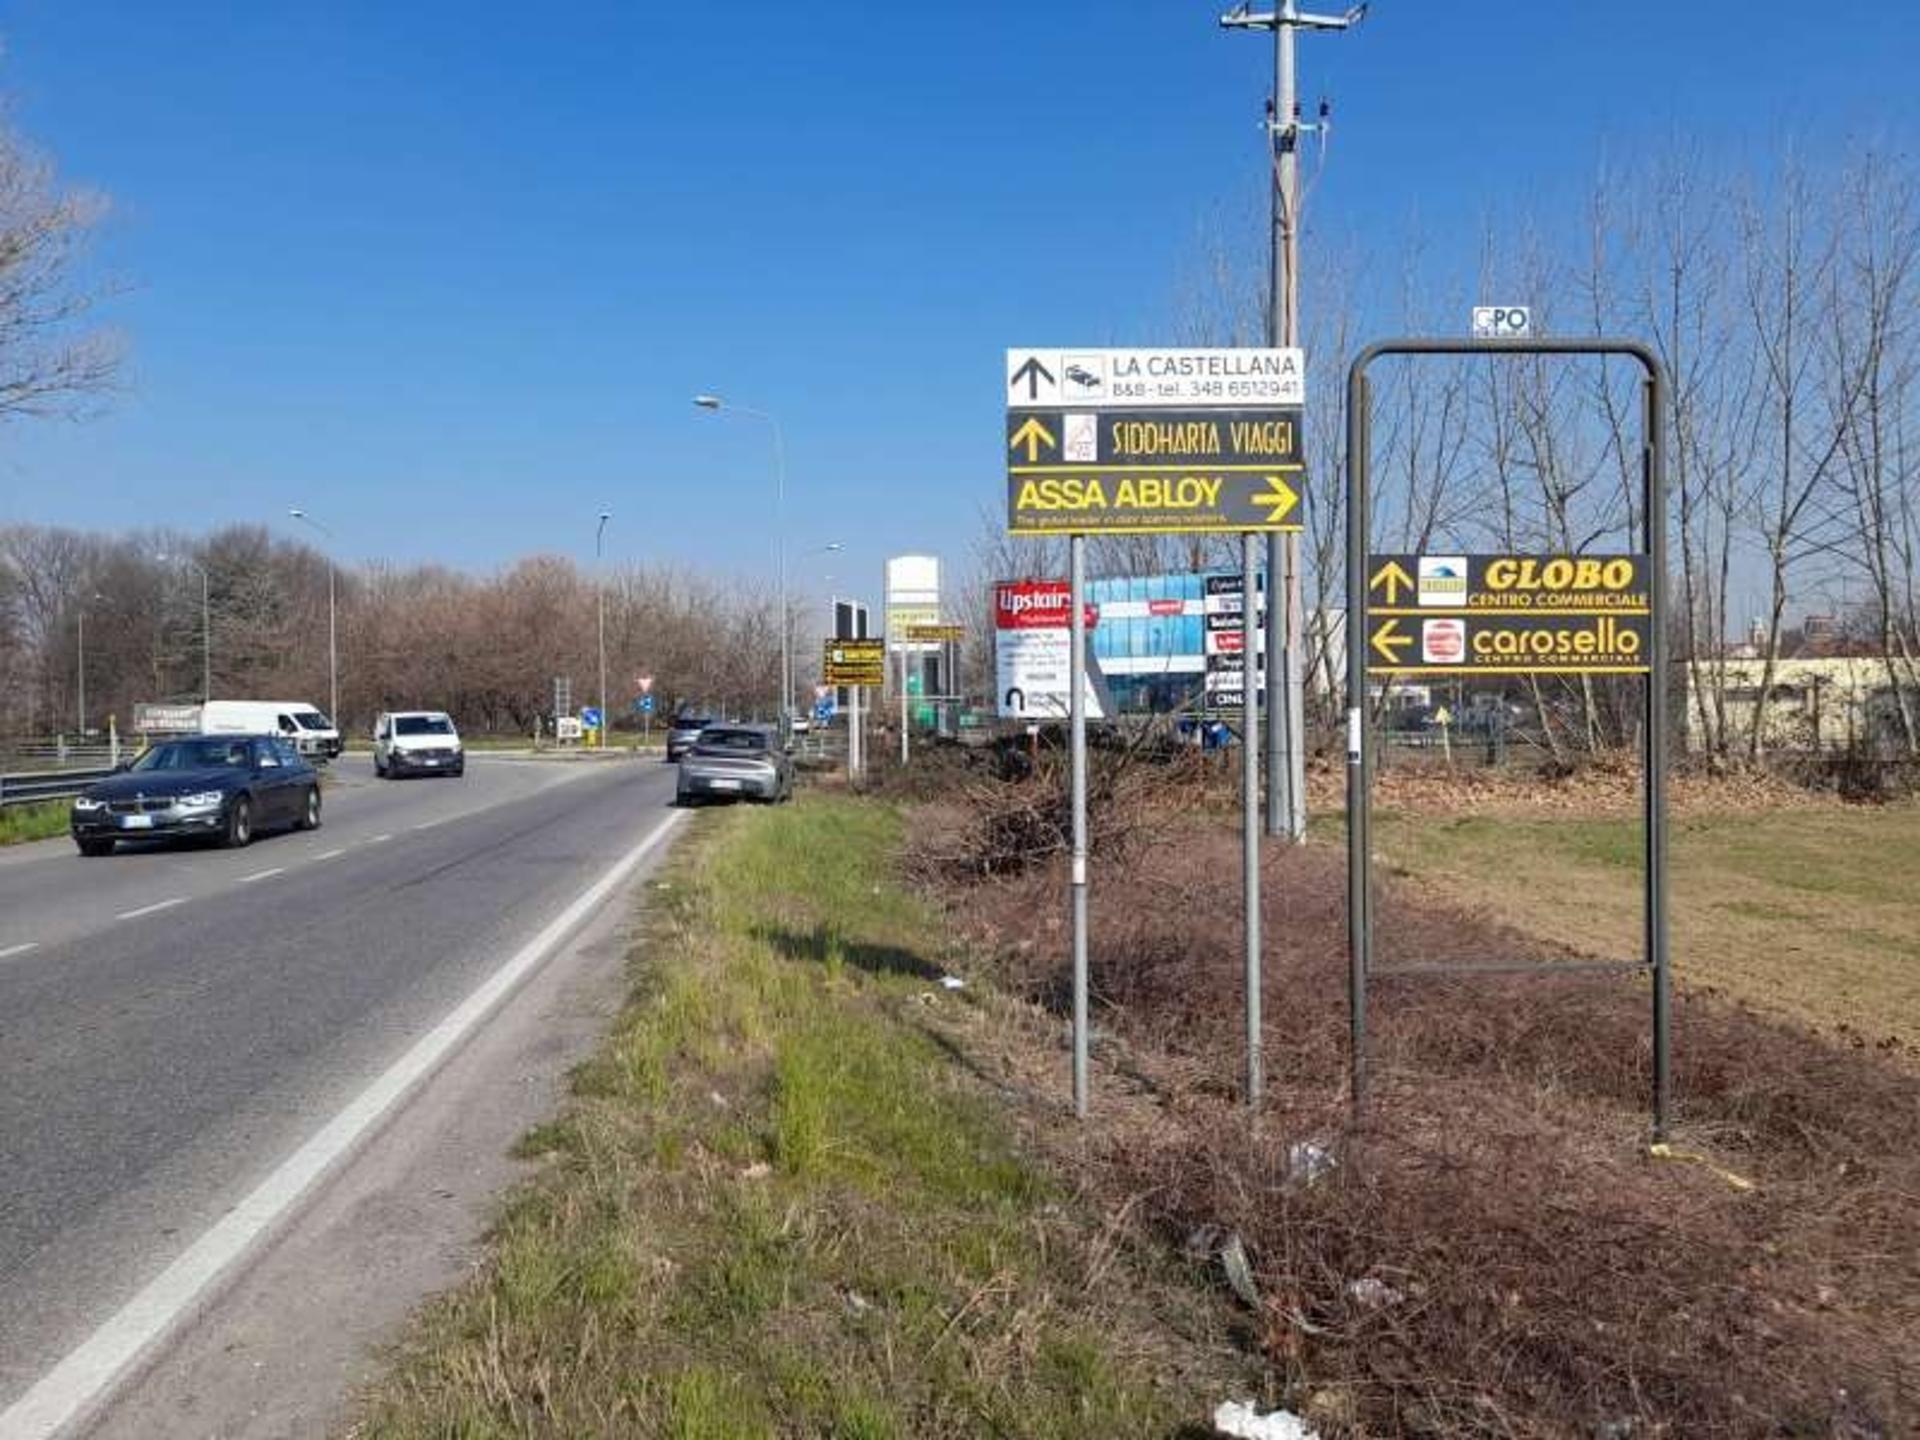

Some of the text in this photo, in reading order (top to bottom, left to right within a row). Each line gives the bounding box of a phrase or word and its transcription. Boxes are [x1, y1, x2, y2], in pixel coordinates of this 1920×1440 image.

[1113, 356, 1296, 376] LA CASTELLANA
[1190, 381, 1223, 396] 348
[1228, 380, 1298, 395] 6512941
[1112, 421, 1221, 455] SIDDHARTA
[1229, 421, 1293, 455] VIAGGI
[1016, 477, 1223, 511] ASSA ABLOY
[1485, 558, 1633, 590] GLOBO
[1468, 592, 1648, 607] CENTRO COMMERCIALE
[1472, 616, 1640, 654] carosello
